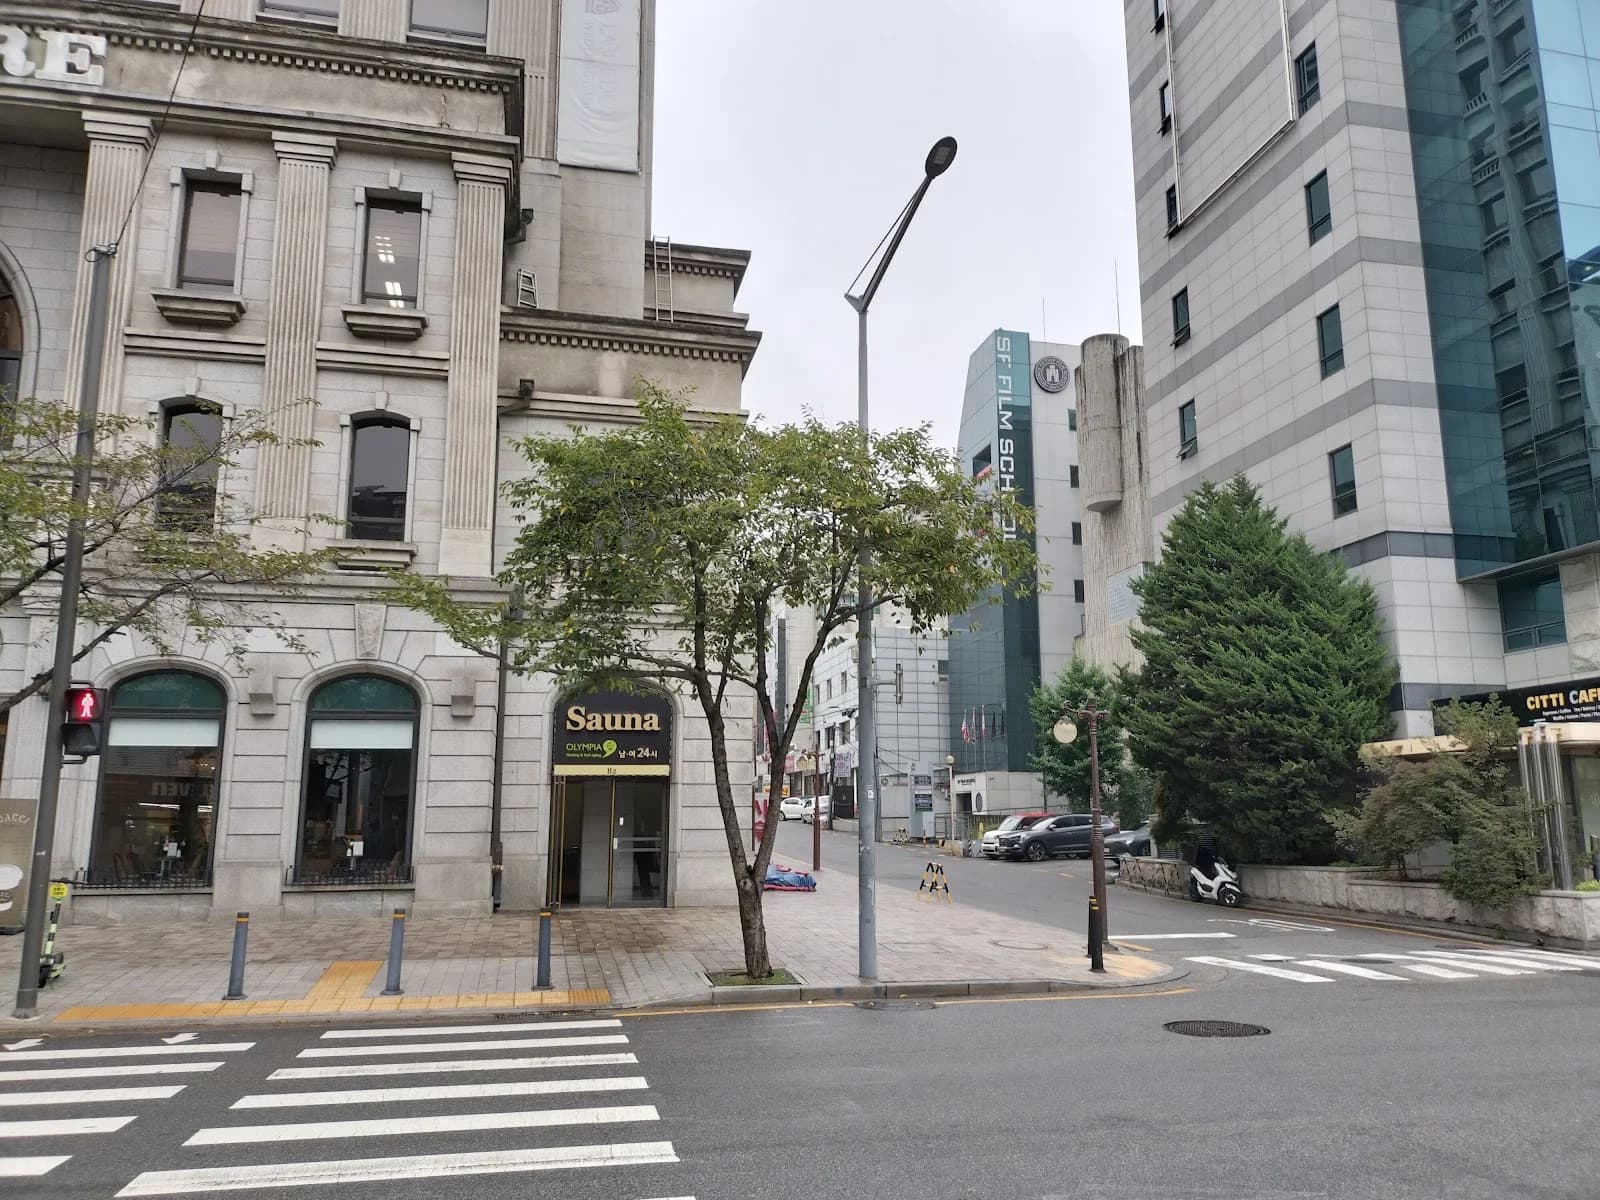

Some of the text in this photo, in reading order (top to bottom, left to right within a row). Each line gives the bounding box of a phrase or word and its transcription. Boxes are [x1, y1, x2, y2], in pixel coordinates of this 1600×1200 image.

[997, 336, 1011, 369] SF
[998, 375, 1013, 430] FILM
[1526, 687, 1600, 710] CITTI CAF
[566, 705, 661, 731] Sauna
[566, 743, 602, 751] OLYMPIA
